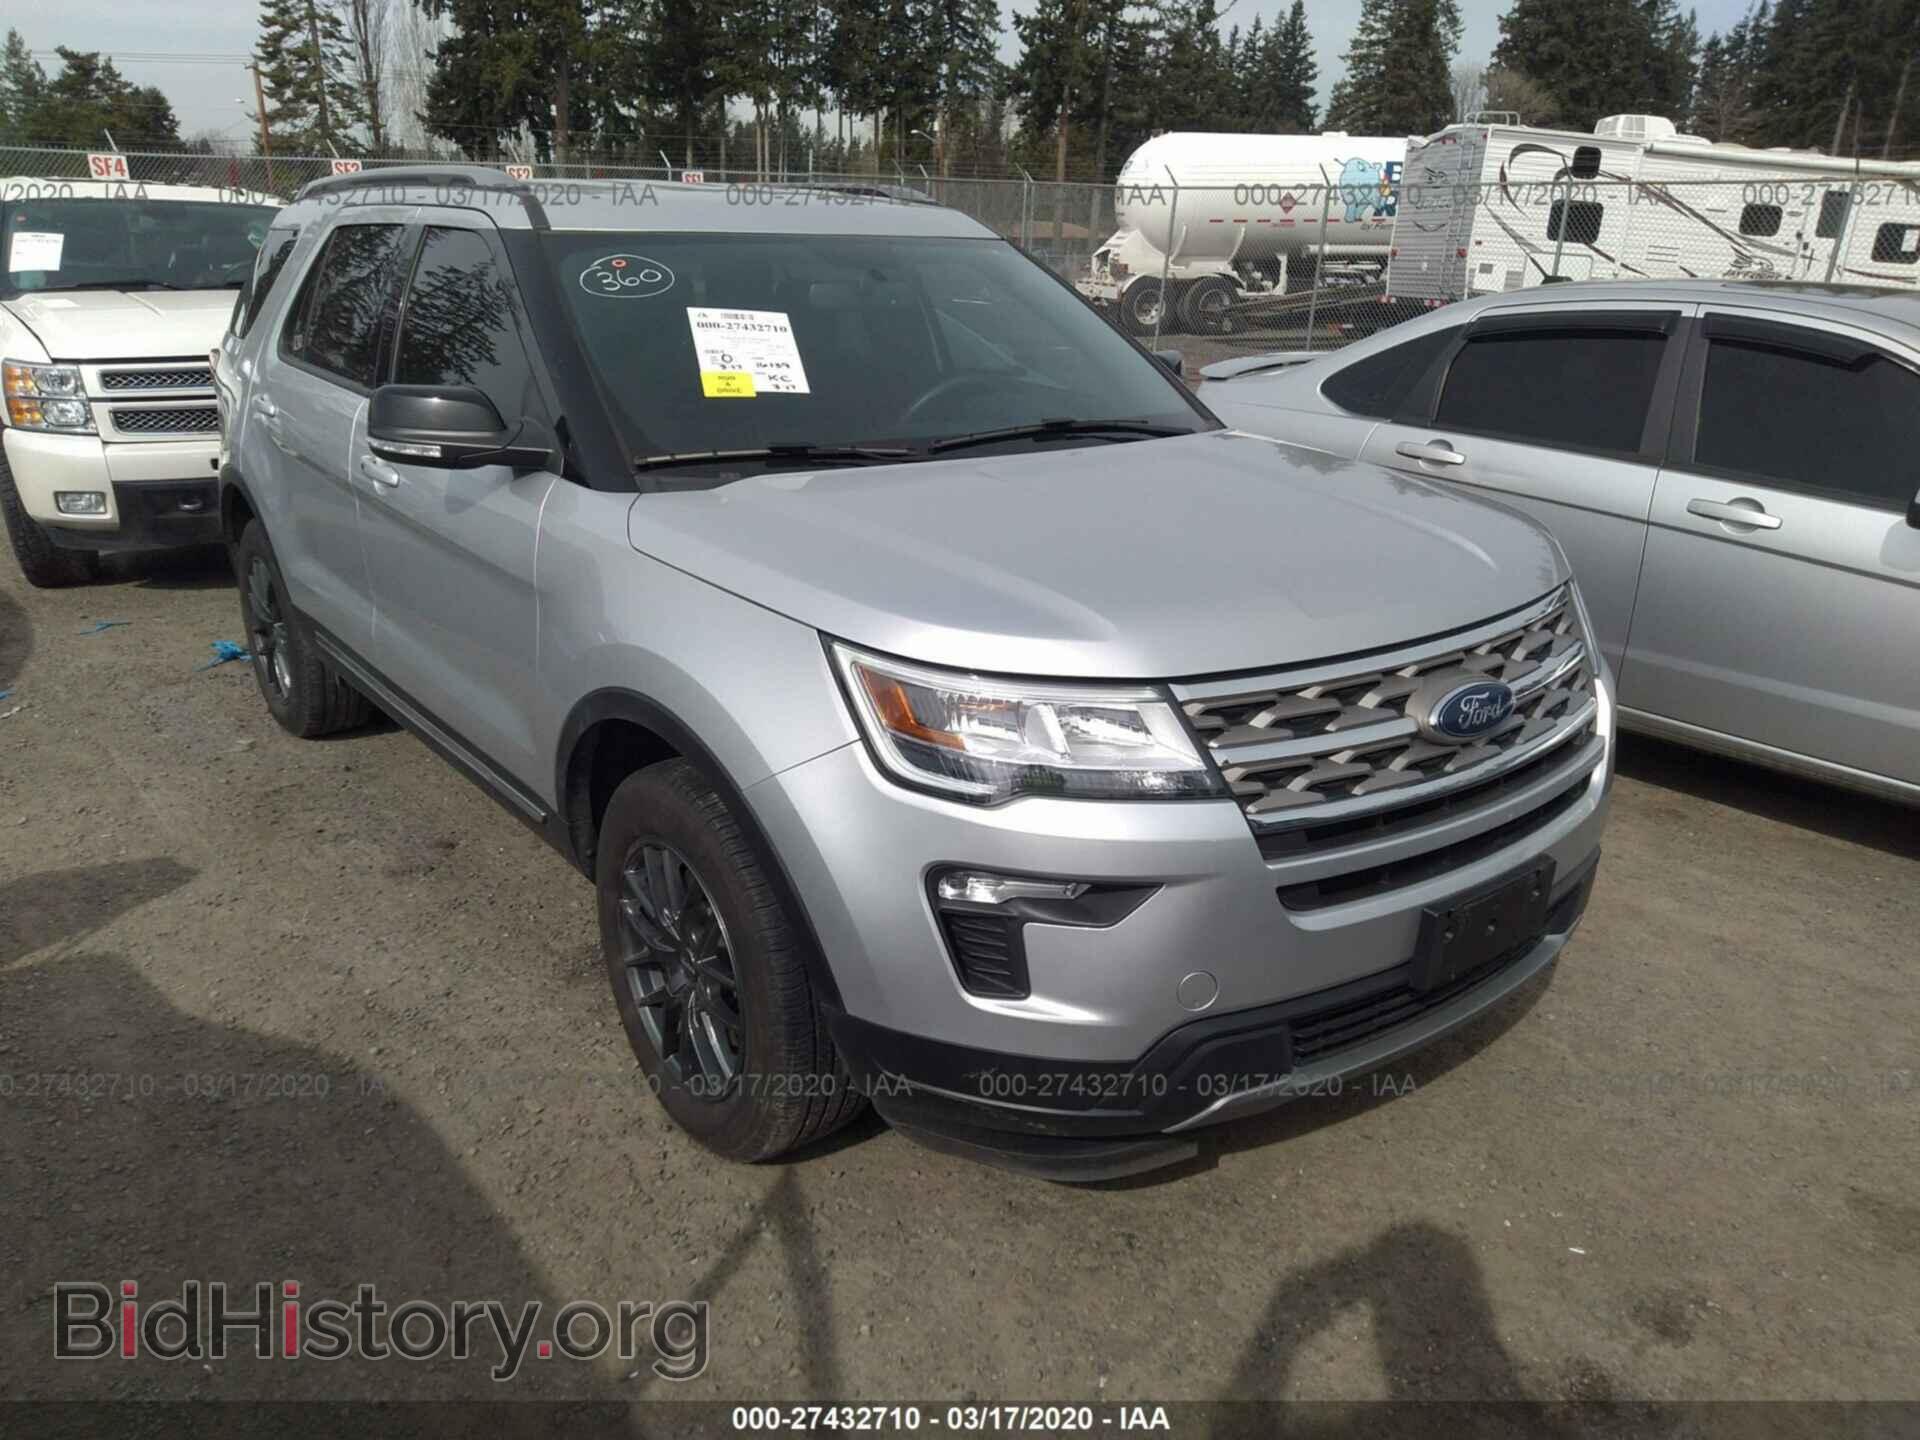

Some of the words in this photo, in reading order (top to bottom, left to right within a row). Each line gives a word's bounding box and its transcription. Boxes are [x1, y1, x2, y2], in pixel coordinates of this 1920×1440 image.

[92, 156, 126, 177] SF4
[597, 269, 662, 291] 360
[696, 321, 788, 333] 000-27432710
[1459, 691, 1505, 730] Ford
